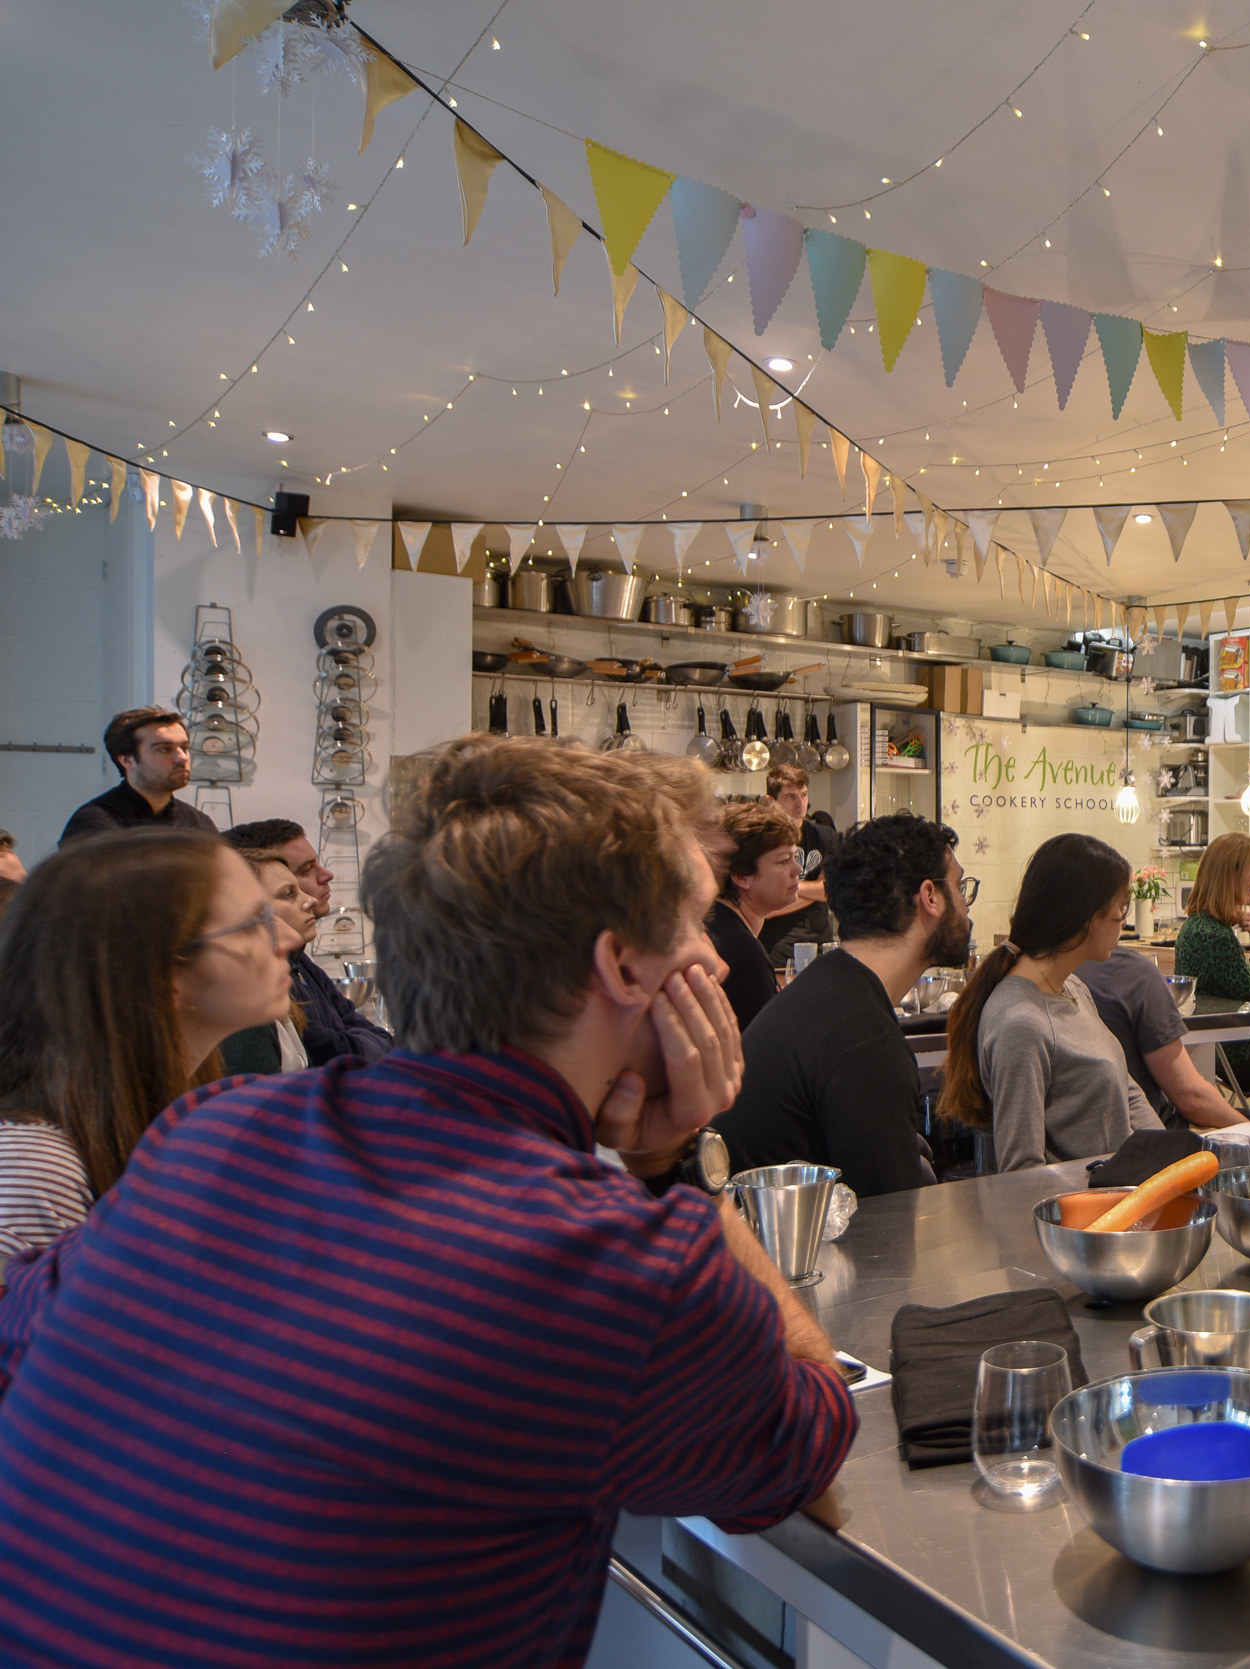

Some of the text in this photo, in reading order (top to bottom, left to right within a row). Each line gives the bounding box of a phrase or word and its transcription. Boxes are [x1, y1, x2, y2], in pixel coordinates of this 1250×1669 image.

[964, 742, 1116, 791] The Avenue
[969, 794, 1115, 810] COOKERY SCHOOL
